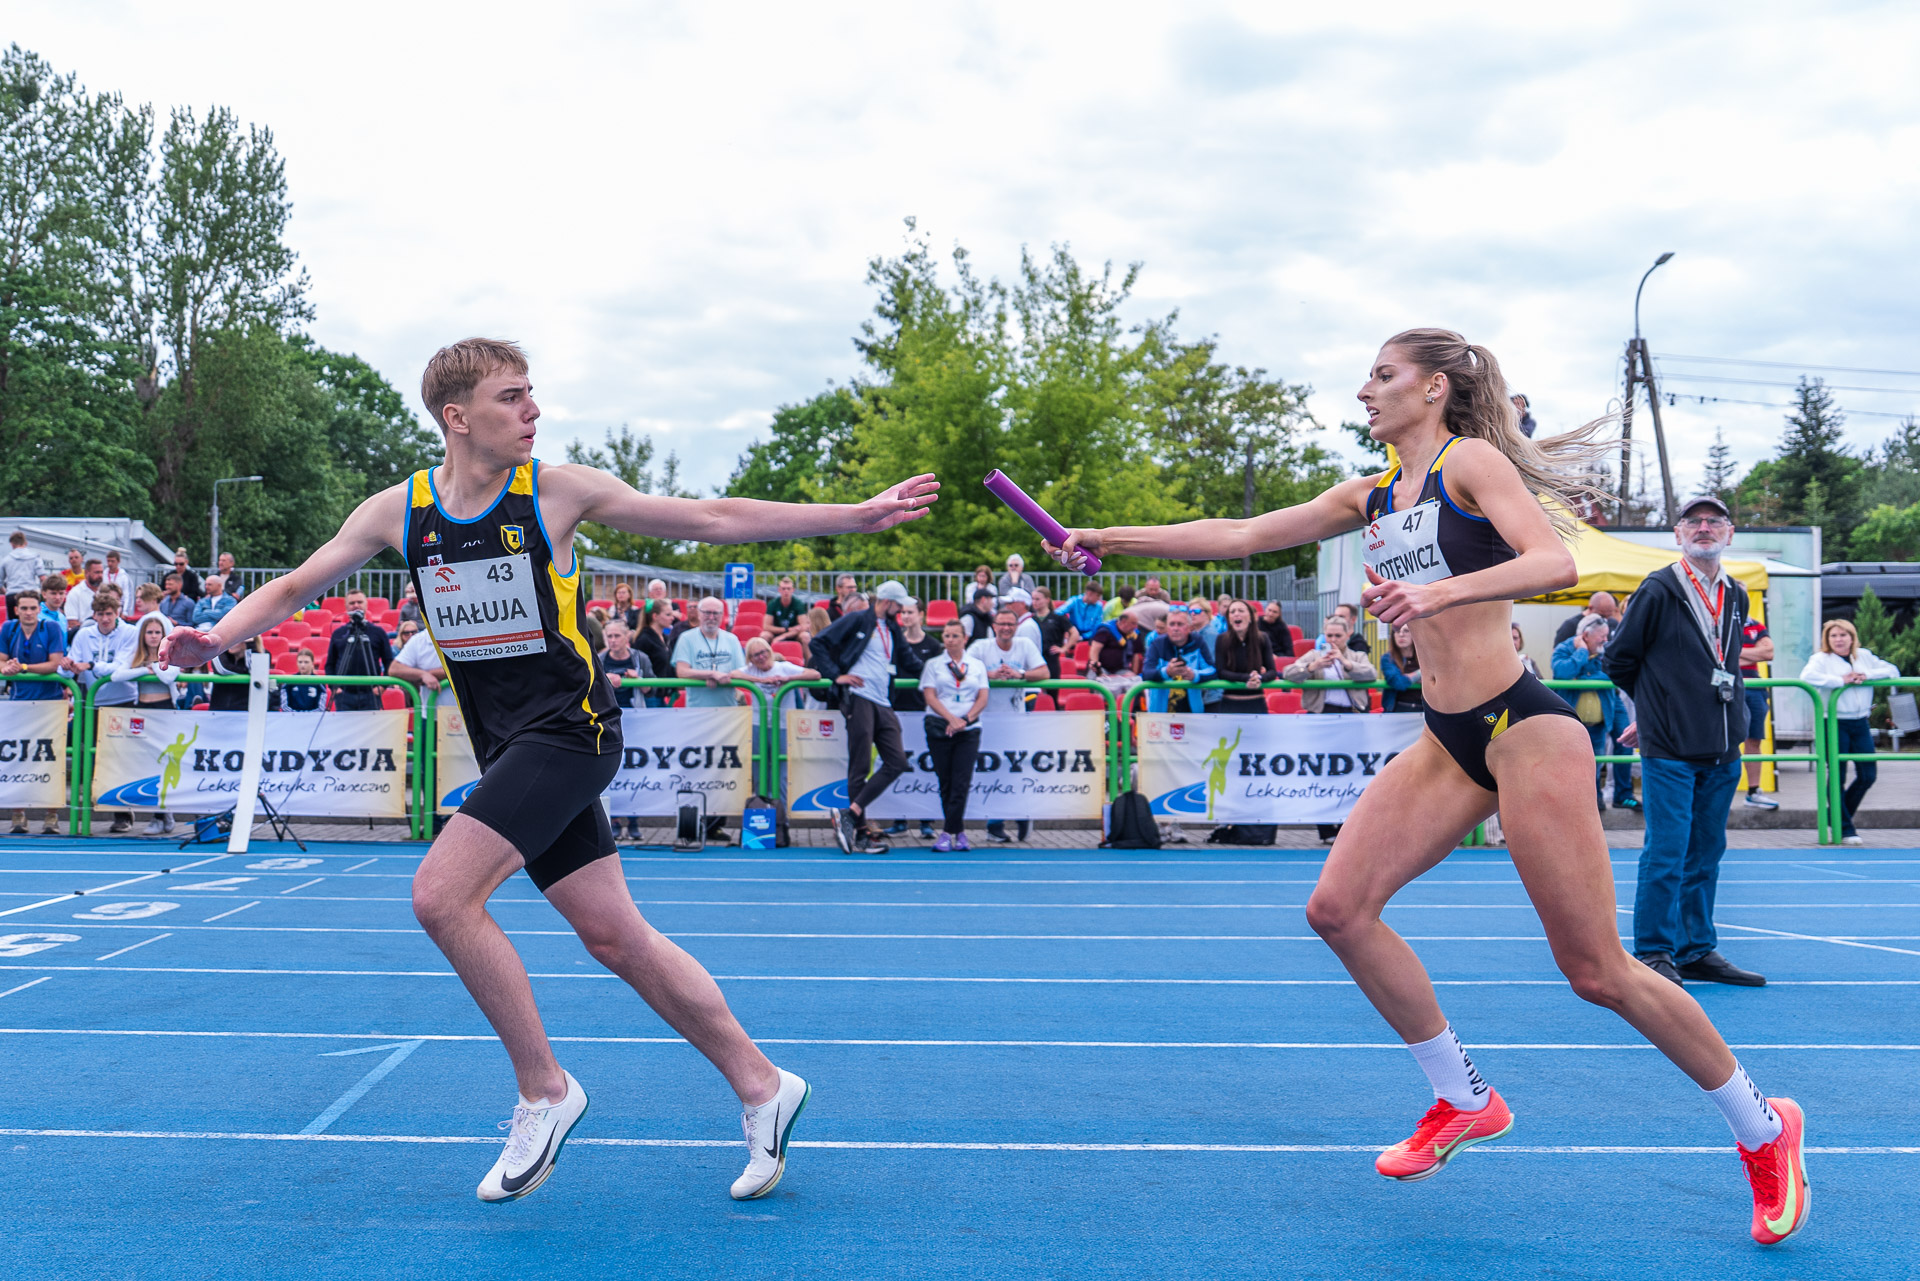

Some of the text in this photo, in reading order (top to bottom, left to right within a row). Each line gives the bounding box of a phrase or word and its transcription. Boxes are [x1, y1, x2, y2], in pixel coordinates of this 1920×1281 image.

[1402, 510, 1424, 533] 47
[1368, 540, 1386, 552] ORLEN
[486, 562, 514, 583] 43
[731, 566, 749, 589] P
[434, 584, 462, 594] ORLEN
[435, 597, 529, 628] HAŁUJA
[452, 643, 529, 659] PIASECZNO 2026
[193, 748, 397, 773] KONDYCJA
[622, 745, 743, 770] DYCJA
[903, 750, 1096, 773] ODYCJA
[1239, 752, 1401, 776] KONDY
[323, 775, 391, 793] Piaseczno
[1021, 778, 1091, 794] Piaseczno
